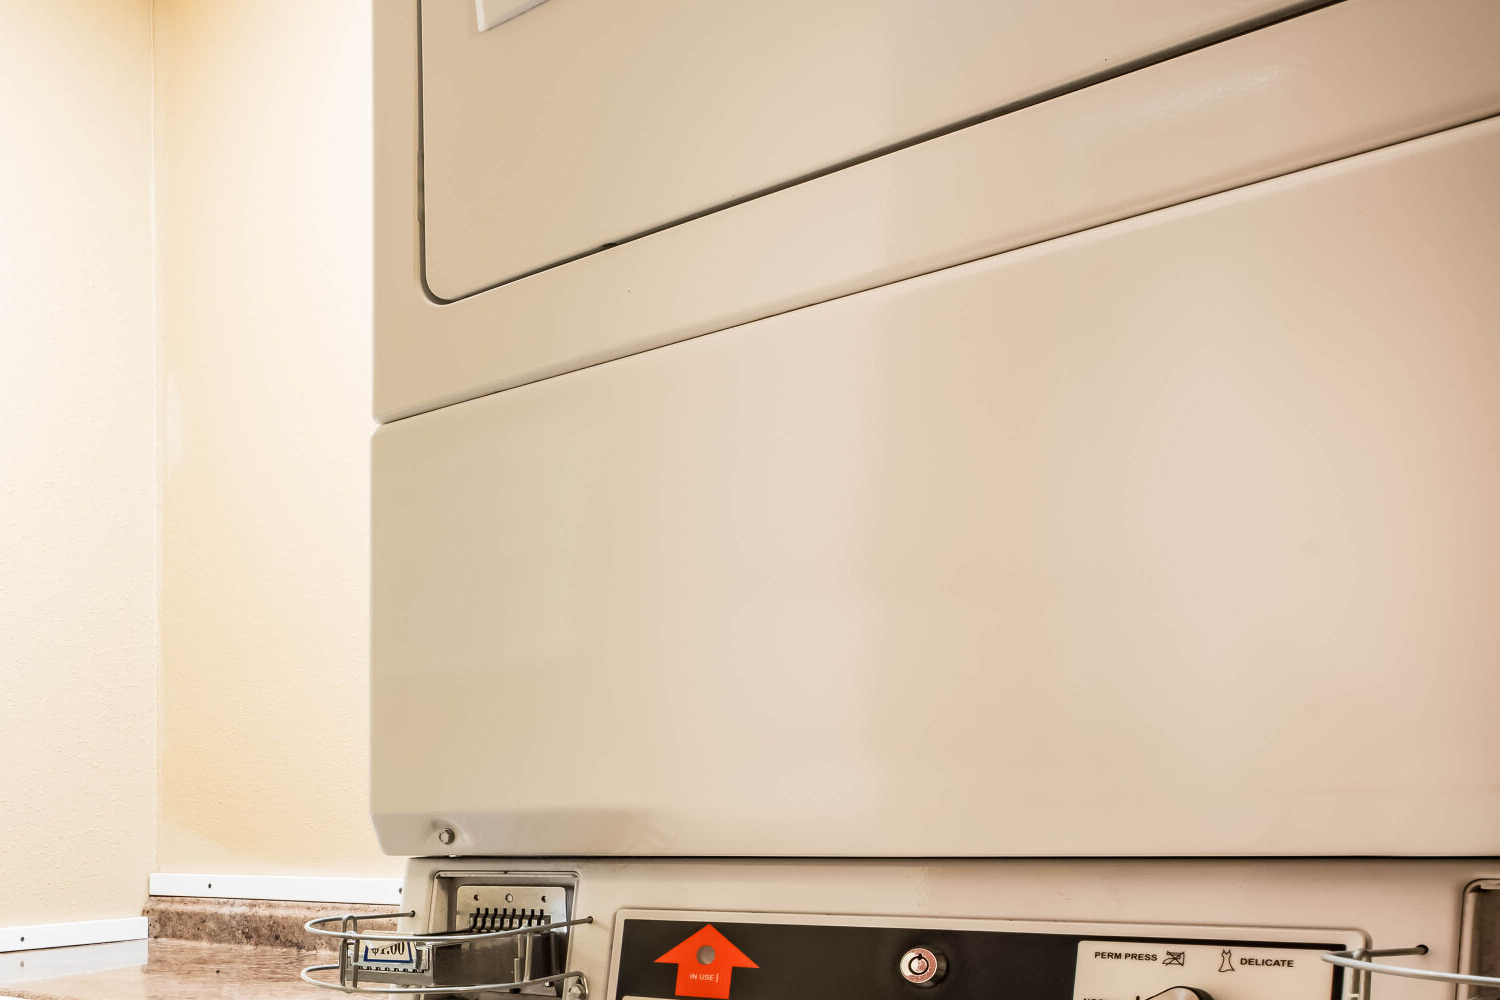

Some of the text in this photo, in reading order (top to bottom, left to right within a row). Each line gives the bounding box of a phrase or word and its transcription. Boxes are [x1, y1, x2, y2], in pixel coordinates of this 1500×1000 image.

[1094, 952, 1158, 962] PERM PRESS
[1240, 957, 1294, 968] DELICATE
